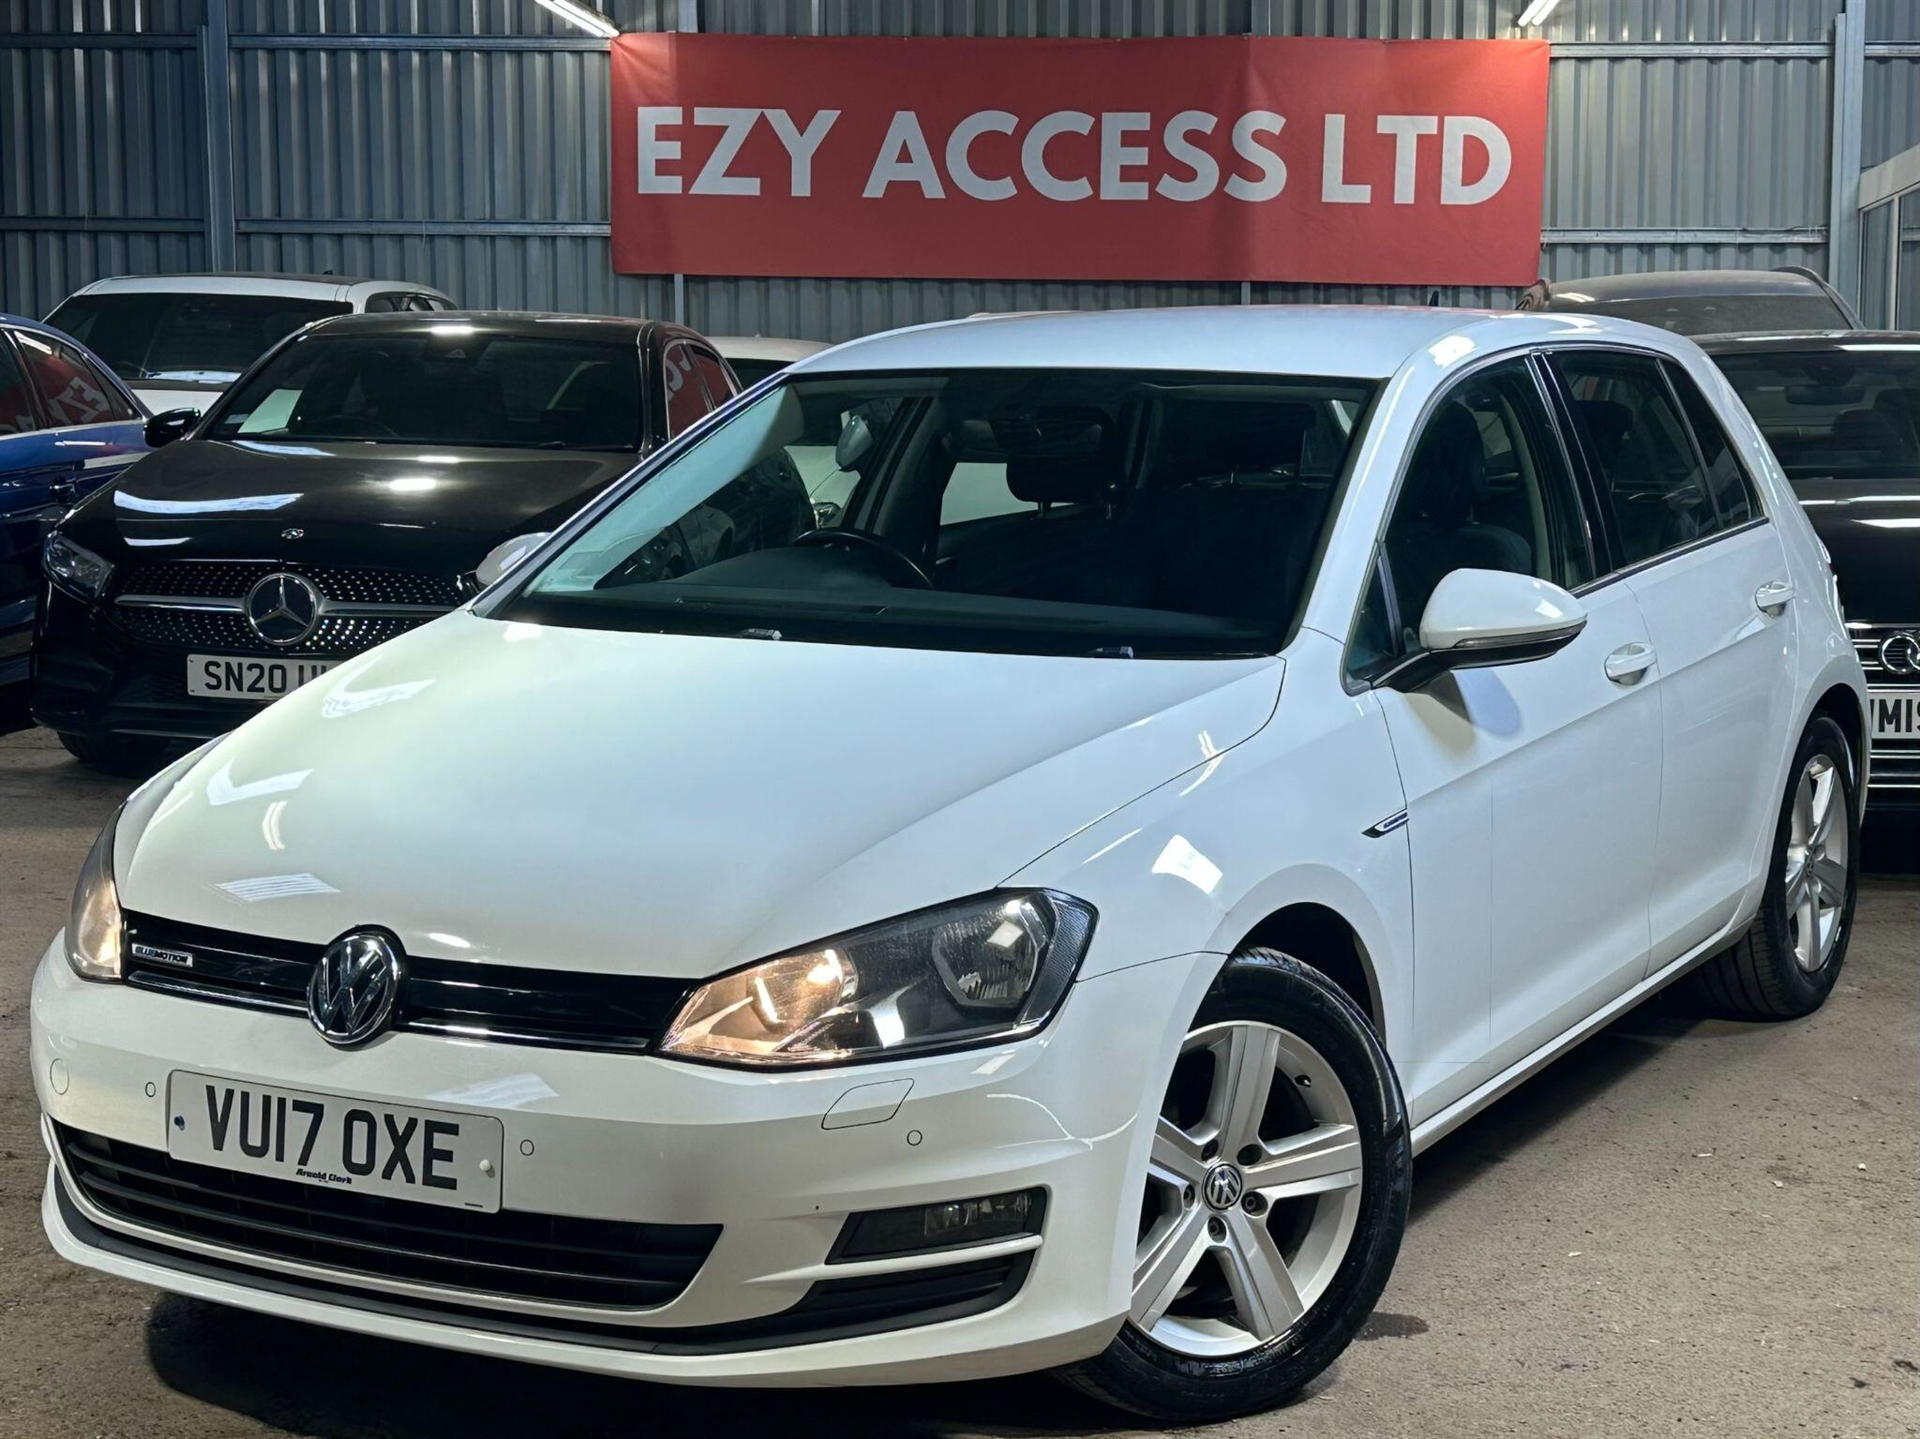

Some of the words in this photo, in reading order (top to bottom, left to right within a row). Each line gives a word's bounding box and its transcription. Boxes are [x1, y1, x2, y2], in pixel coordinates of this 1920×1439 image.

[637, 106, 841, 197] EZY
[862, 110, 1288, 202] ACCESS
[1321, 113, 1513, 206] LTD
[204, 660, 287, 693] SN20
[205, 1084, 325, 1167] VU17
[342, 1108, 460, 1190] OXE
